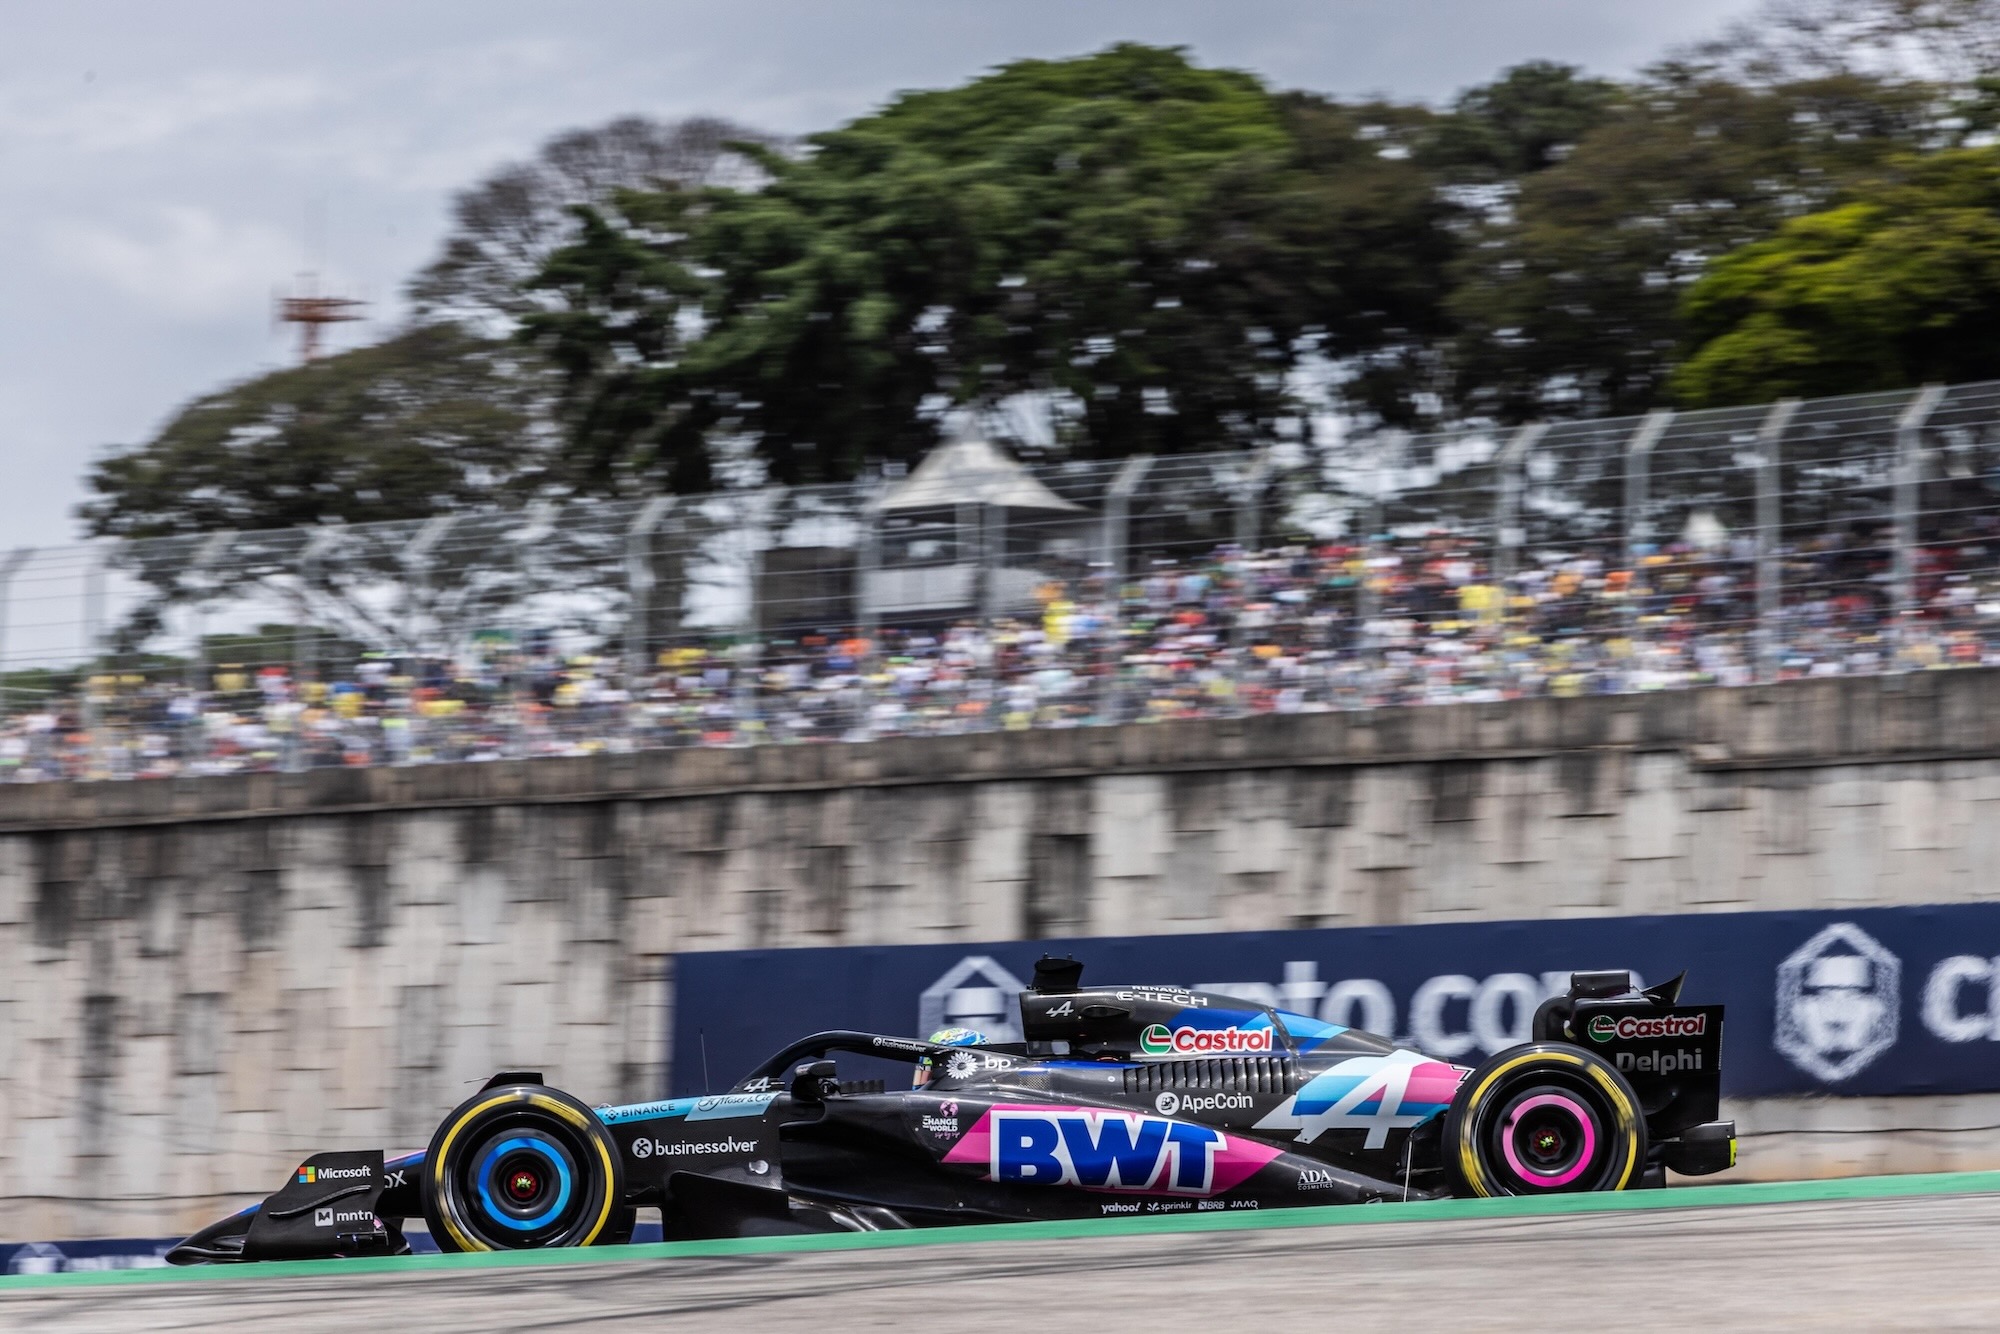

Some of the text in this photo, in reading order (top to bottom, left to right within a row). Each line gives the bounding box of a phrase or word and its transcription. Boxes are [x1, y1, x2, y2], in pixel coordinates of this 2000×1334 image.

[1131, 985, 1192, 995] RENAULT
[1119, 991, 1208, 1006] E-TECH
[1617, 1014, 1706, 1039] Castrol
[1174, 1026, 1273, 1052] Castrol
[984, 1055, 1012, 1071] bp
[1616, 1048, 1702, 1076] Delphi
[621, 1103, 676, 1118] BINANCE
[1181, 1092, 1254, 1114] ApeCoin
[922, 1118, 958, 1126] CHANGE
[655, 1136, 759, 1156] businessolver
[990, 1110, 1228, 1194] BWT
[318, 1165, 372, 1180] Microsoft
[1298, 1169, 1332, 1183] ADA
[1297, 1182, 1334, 1191] COSMETICS
[1101, 1202, 1141, 1214] yahoo!
[1160, 1201, 1193, 1212] sprinklr
[1207, 1201, 1226, 1210] BRB
[336, 1210, 374, 1222] mntn
